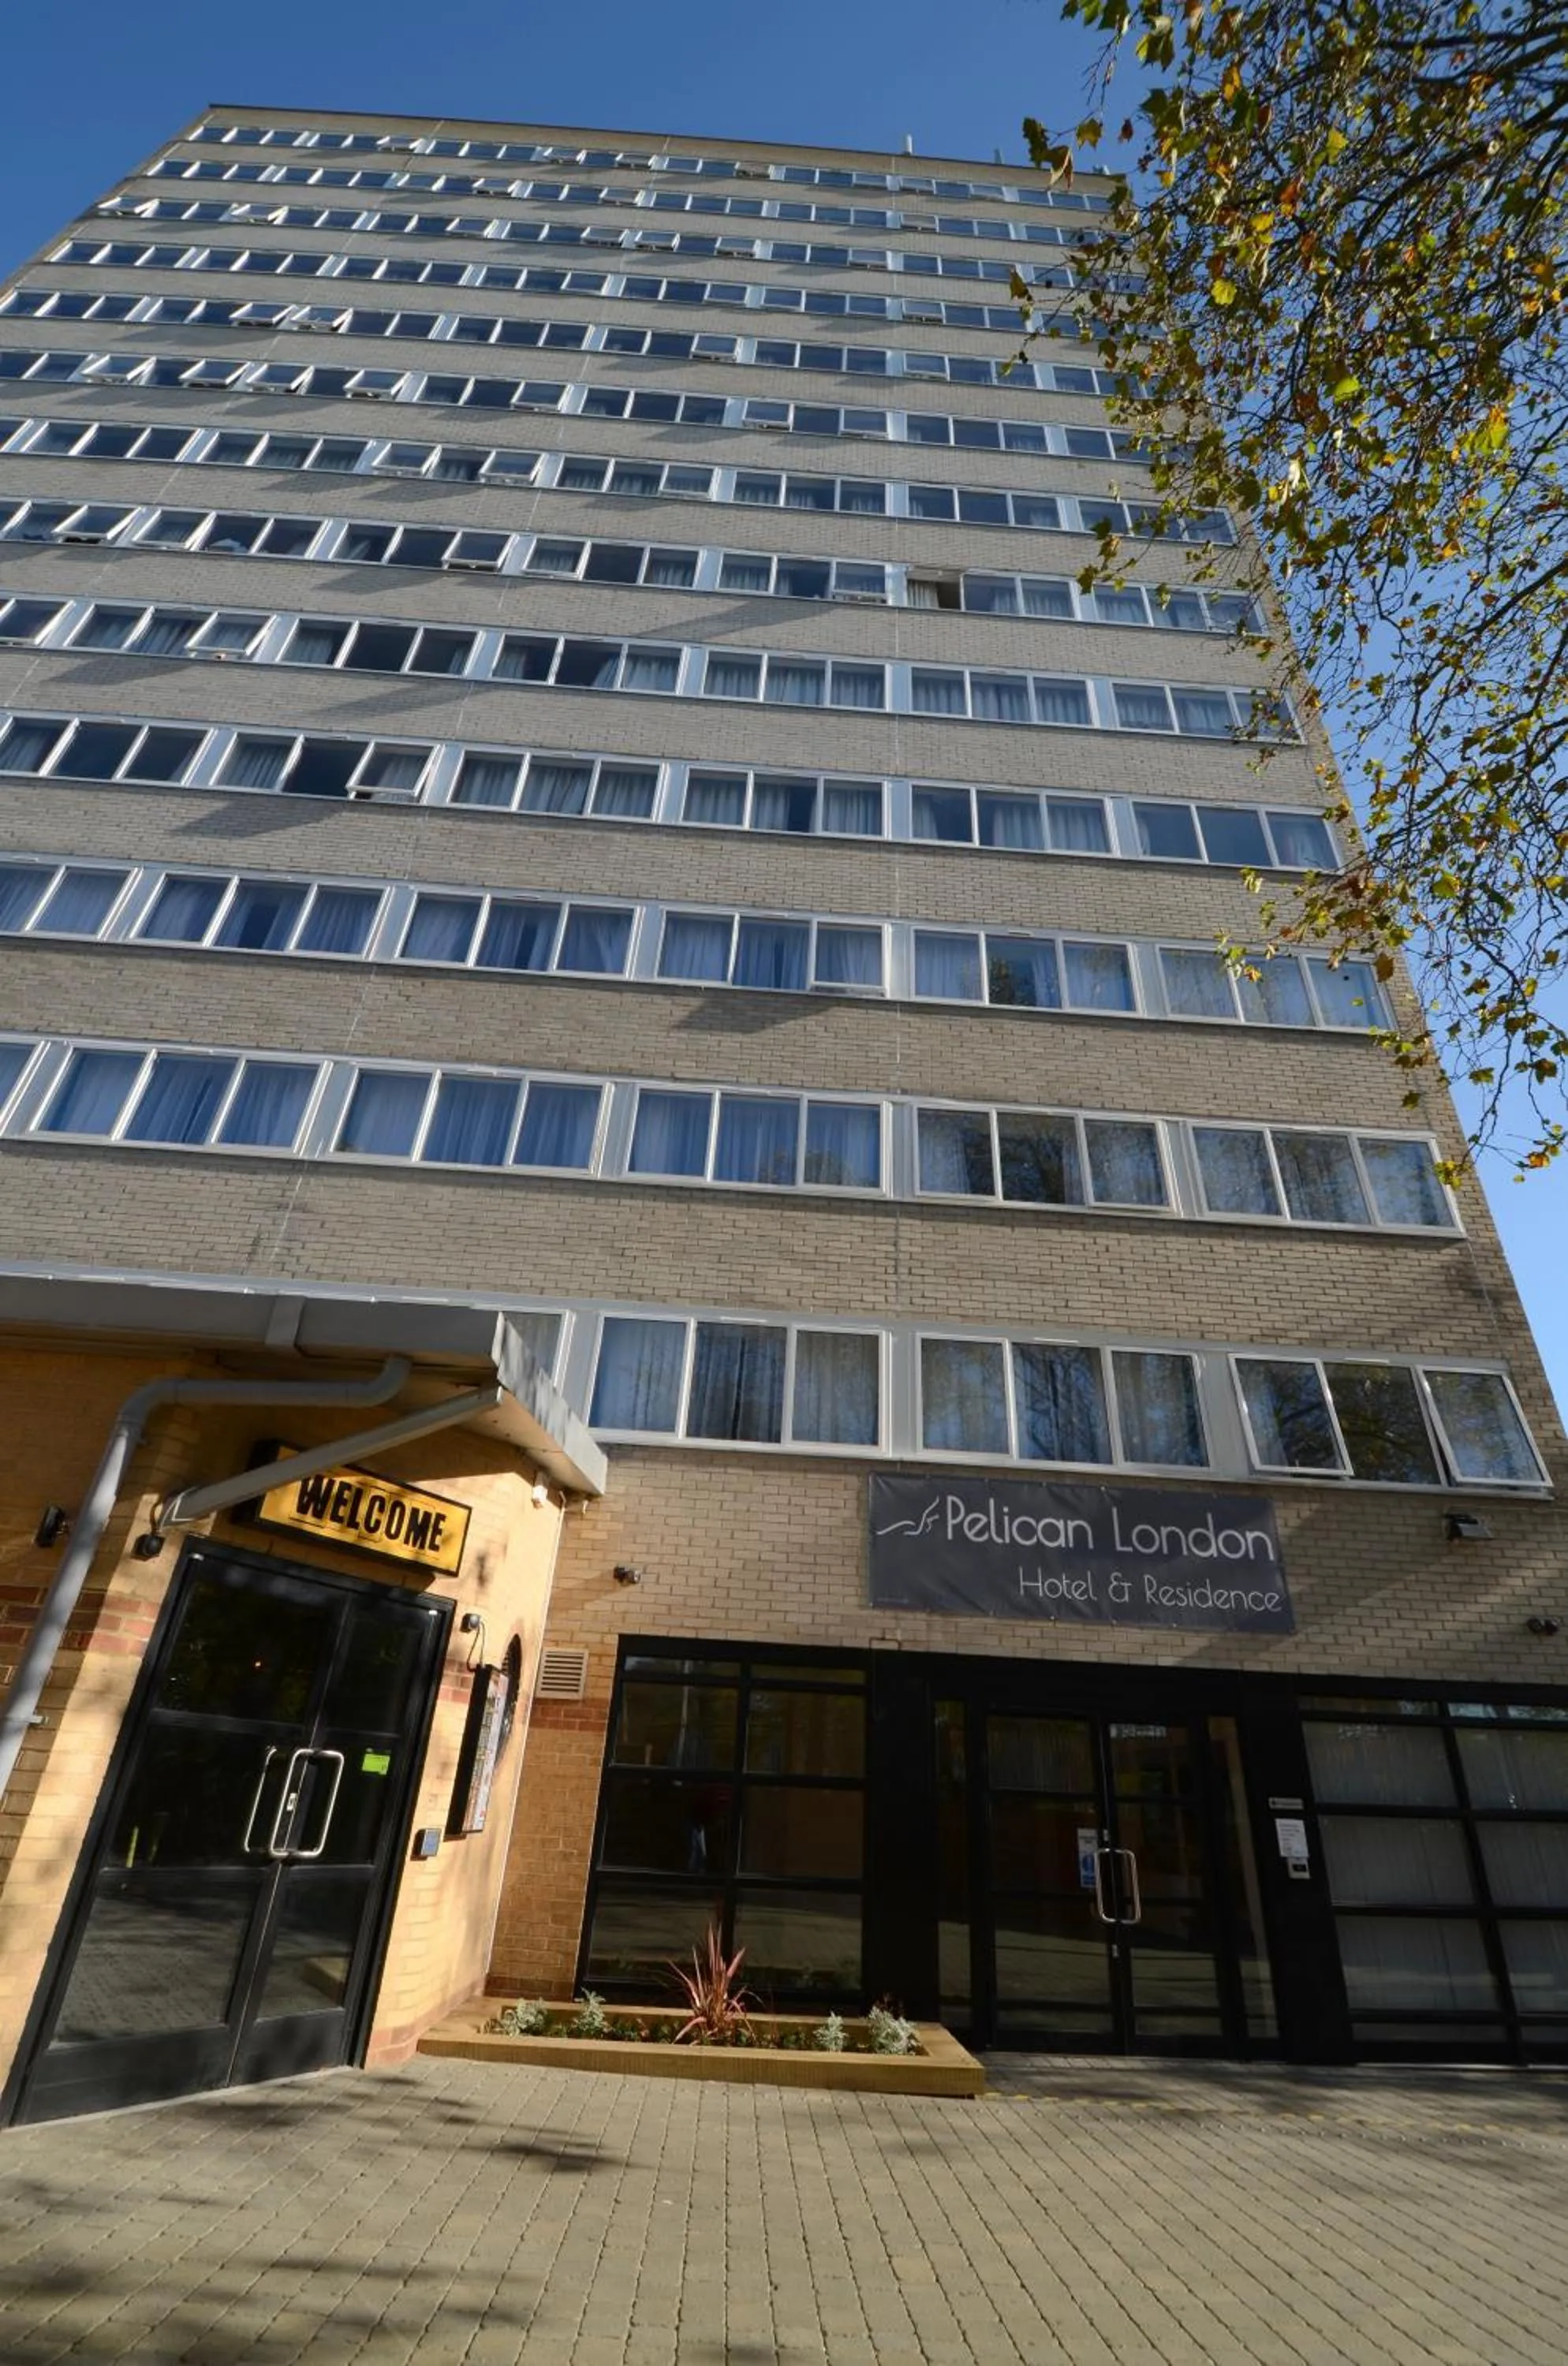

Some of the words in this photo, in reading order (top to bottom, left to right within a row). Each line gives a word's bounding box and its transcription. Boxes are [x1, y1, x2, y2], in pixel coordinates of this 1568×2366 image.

[296, 1474, 447, 1552] WELCOME
[946, 1495, 1094, 1550] Pelican
[1111, 1507, 1275, 1562] London
[1019, 1567, 1097, 1602] Hotel
[1109, 1572, 1130, 1603] &
[1145, 1574, 1282, 1613] Residence
